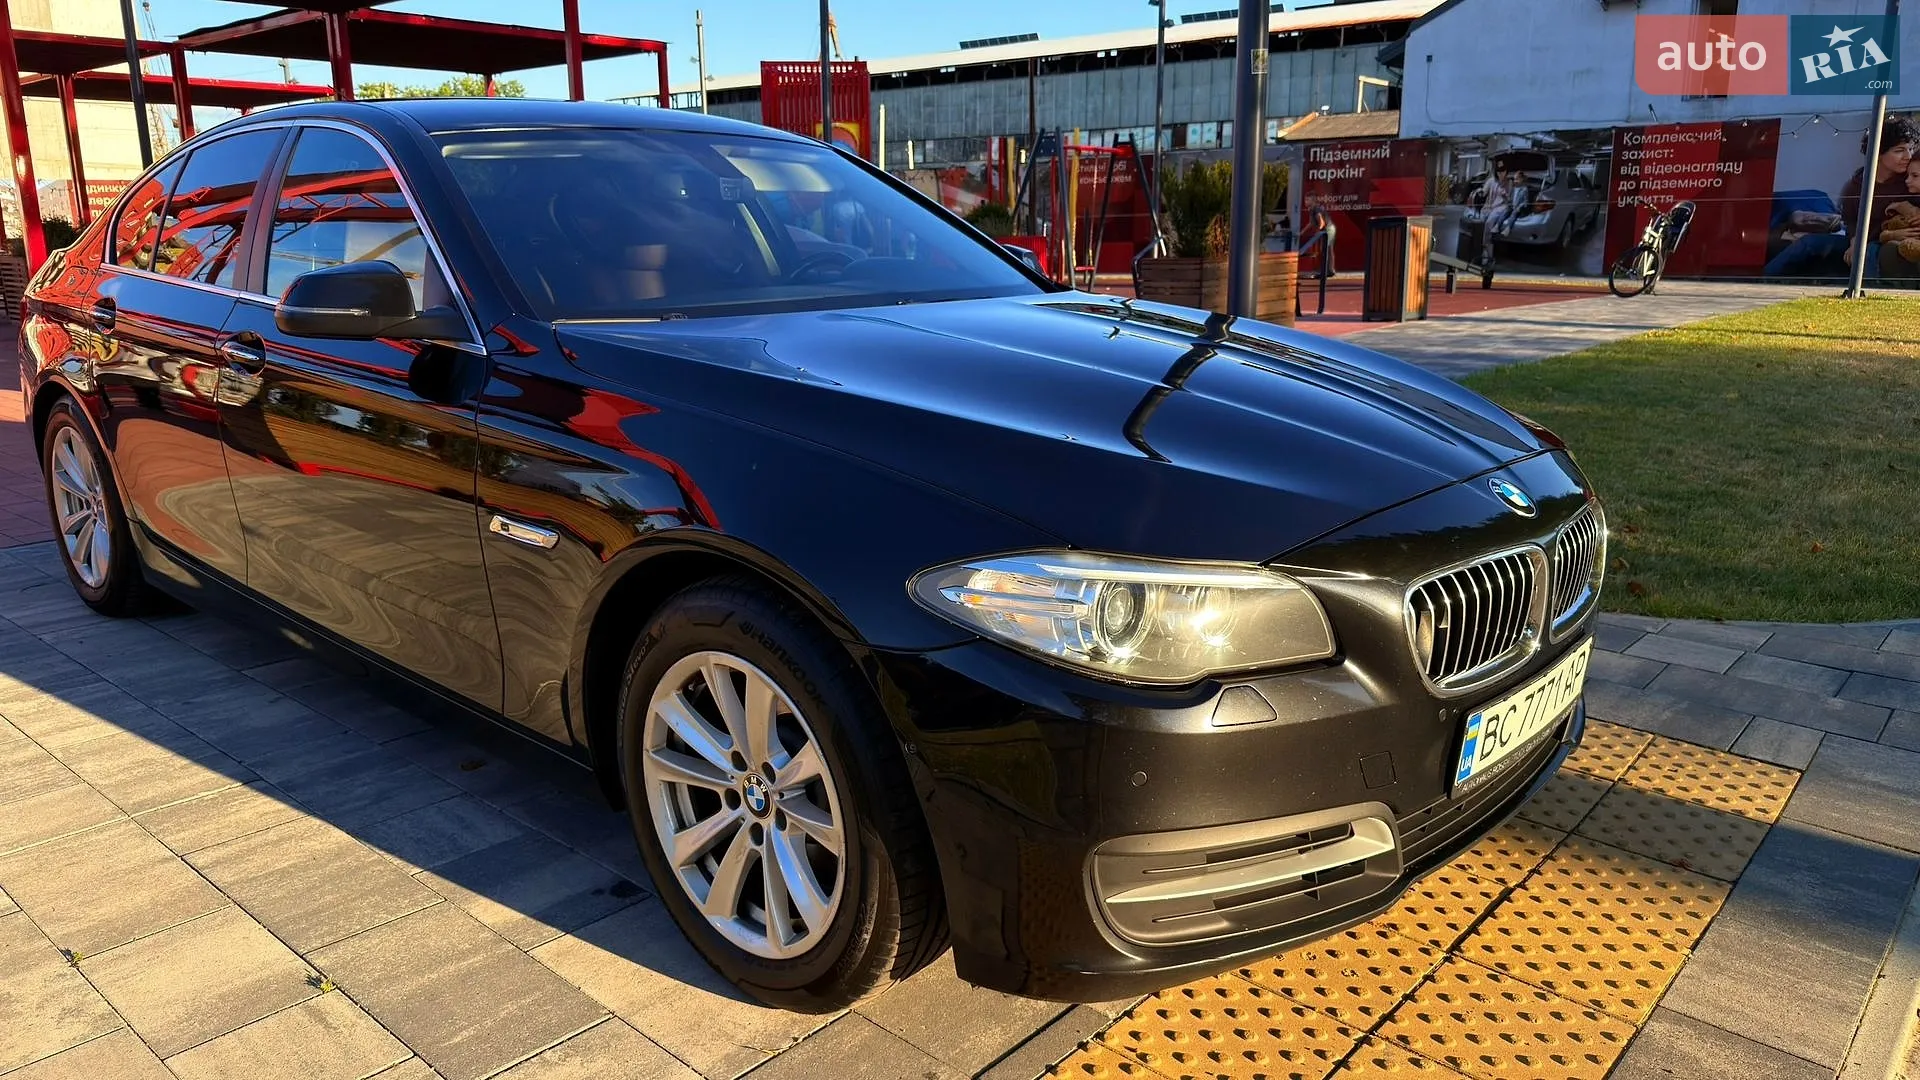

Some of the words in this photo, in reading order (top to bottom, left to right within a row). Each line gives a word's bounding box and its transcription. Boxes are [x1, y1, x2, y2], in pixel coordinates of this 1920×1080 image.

[1309, 145, 1390, 162] Підземний
[1621, 148, 1674, 160] захист:
[1309, 165, 1365, 182] паркінг
[1620, 163, 1640, 175] від
[1644, 161, 1743, 174] відеонагляду
[1618, 180, 1636, 191] до
[1640, 178, 1722, 190] підземного
[1617, 194, 1674, 207] укриття
[1479, 704, 1517, 762] BC
[1517, 670, 1564, 738] 7771
[1561, 650, 1586, 703] AP
[1461, 754, 1473, 771] UA
[743, 776, 767, 793] BMW
